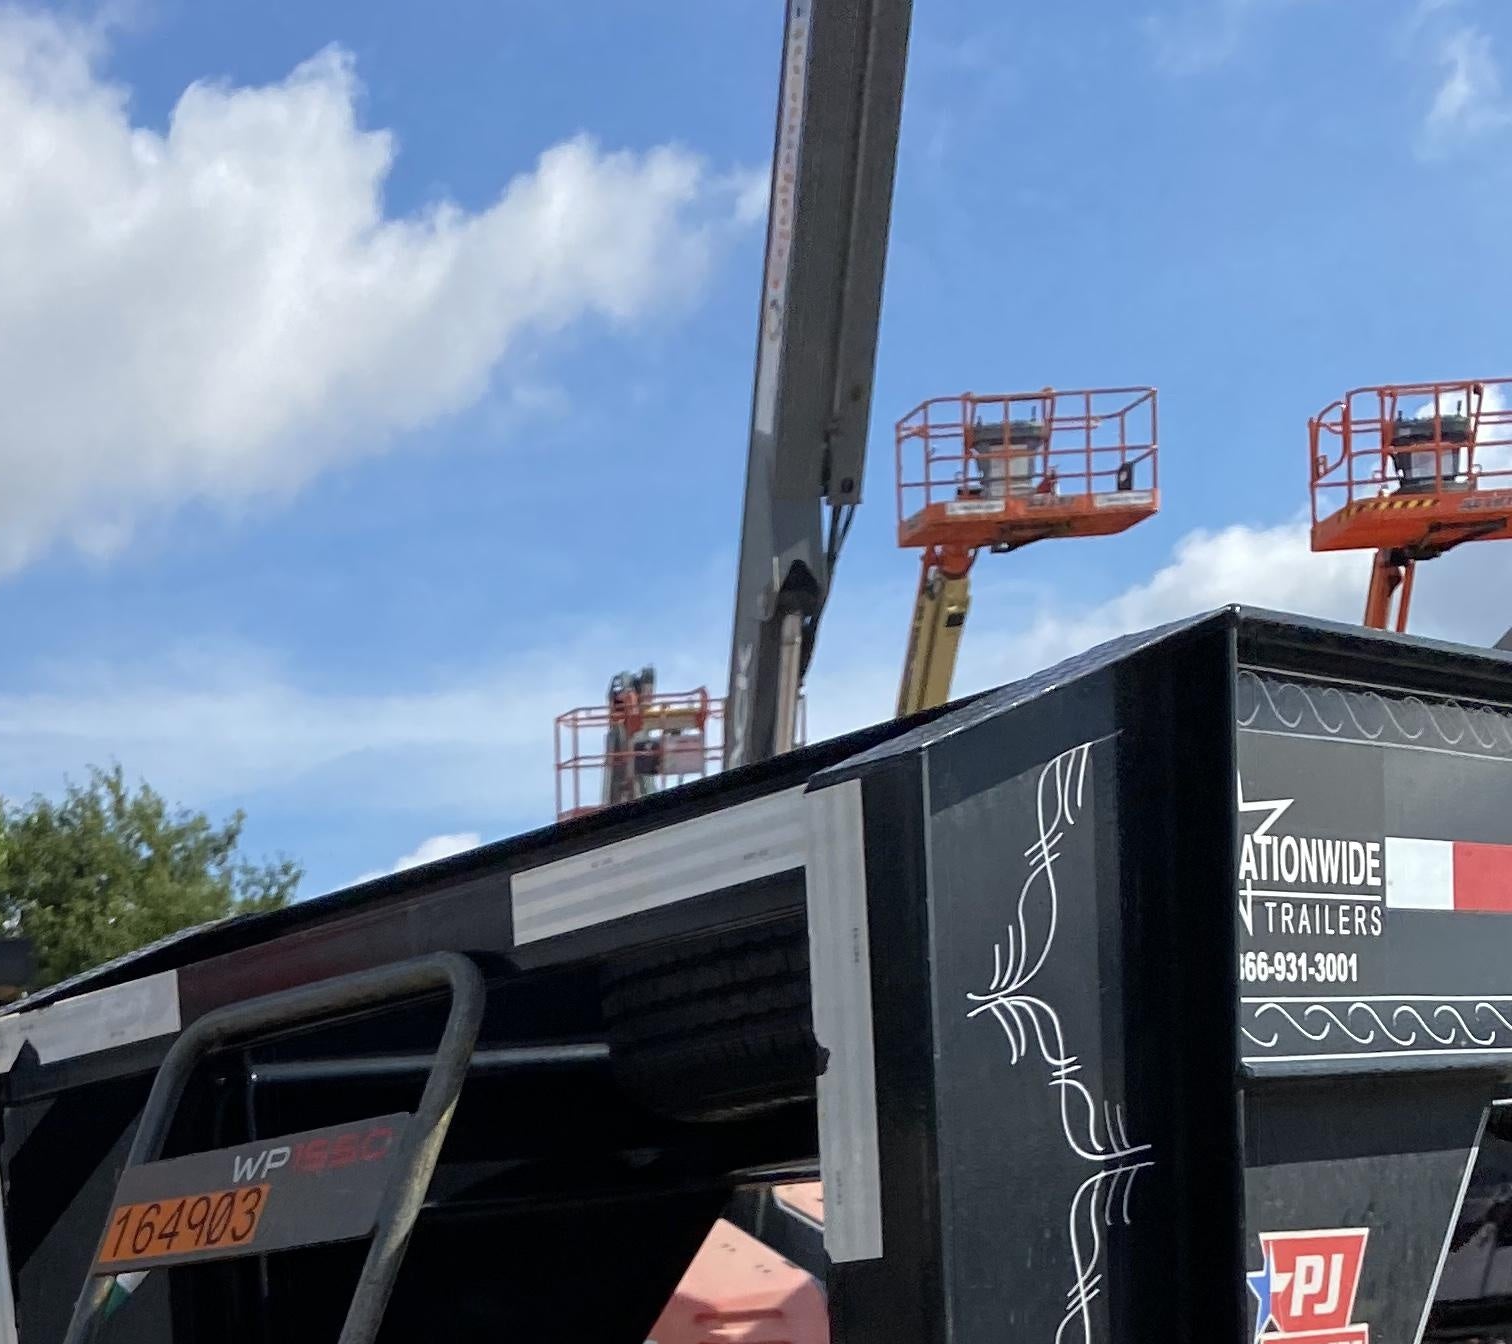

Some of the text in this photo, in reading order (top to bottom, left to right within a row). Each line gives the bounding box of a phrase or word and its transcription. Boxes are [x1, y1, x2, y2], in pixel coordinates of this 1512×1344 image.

[1264, 902, 1383, 937] TRAILERS
[112, 1186, 262, 1258] 164903
[1289, 1253, 1345, 1318] PJ
